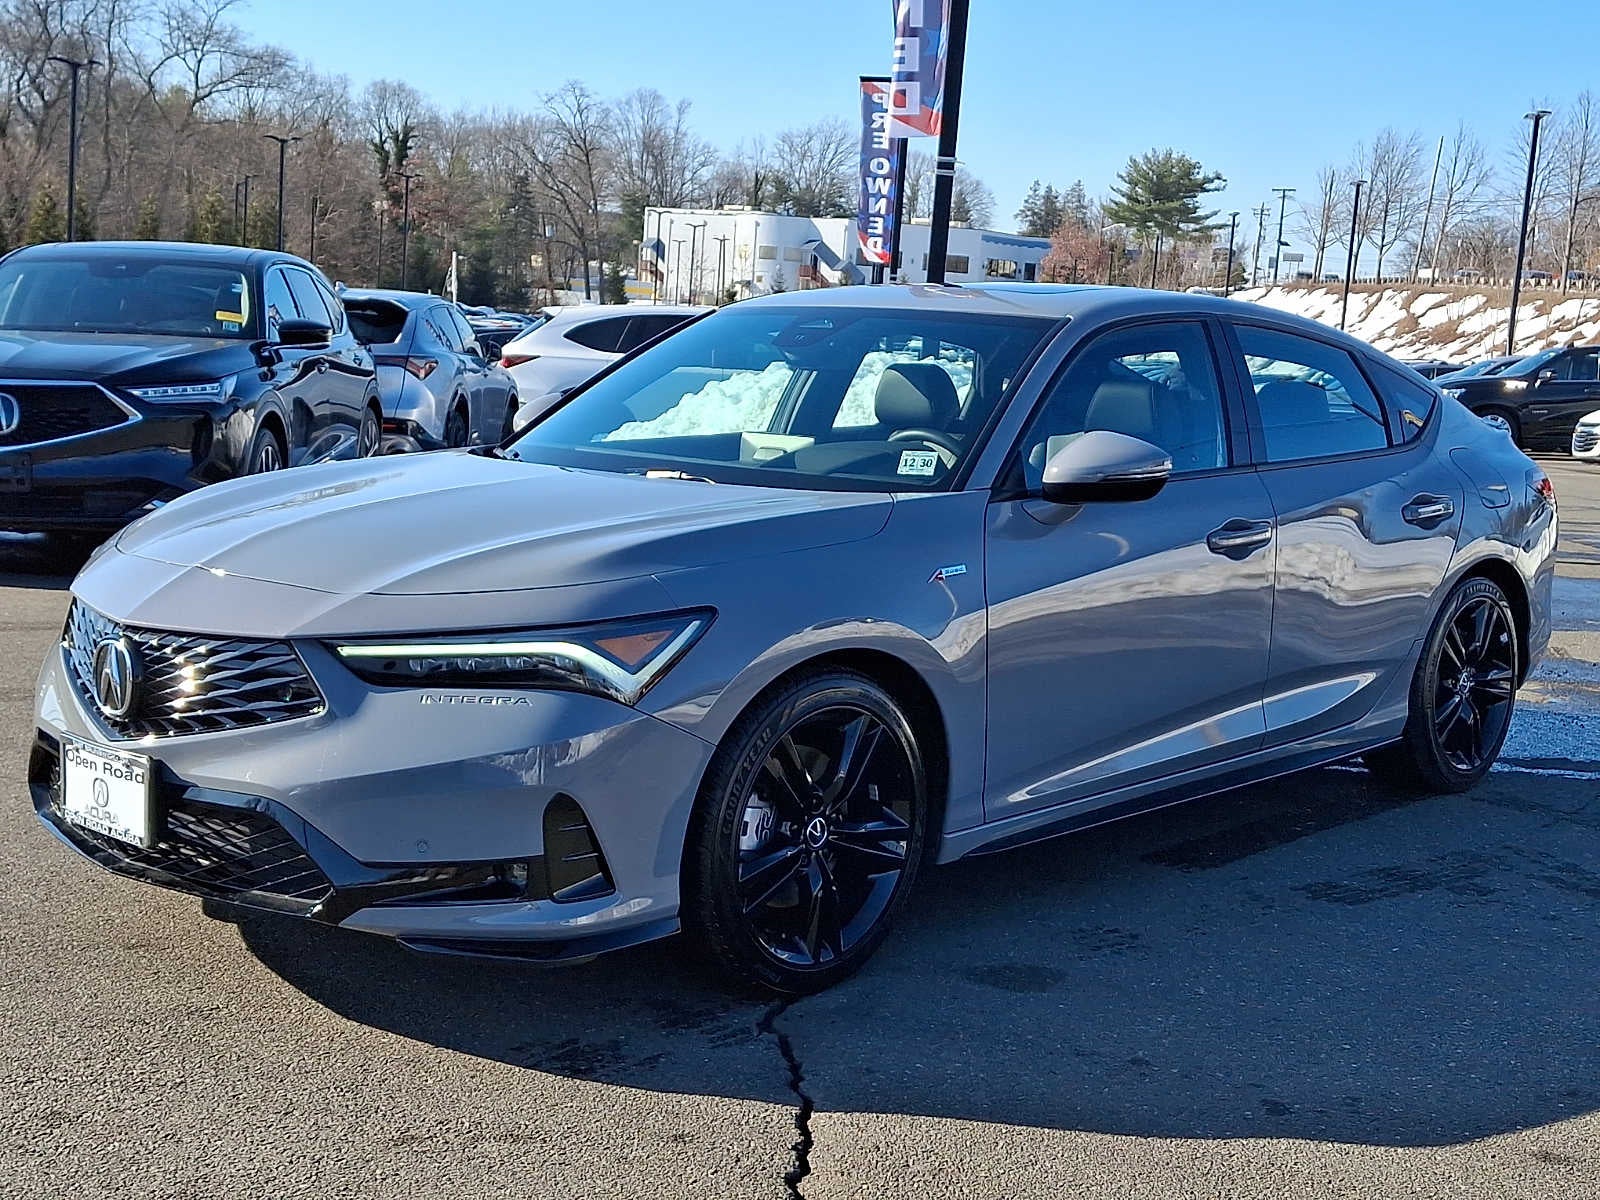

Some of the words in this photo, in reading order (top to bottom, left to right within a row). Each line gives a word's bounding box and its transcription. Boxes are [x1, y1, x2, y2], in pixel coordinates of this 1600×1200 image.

[902, 457, 916, 467] 12
[919, 458, 933, 468] 30
[419, 694, 534, 707] INTEGRA
[65, 748, 98, 772] Open
[103, 761, 145, 785] Road
